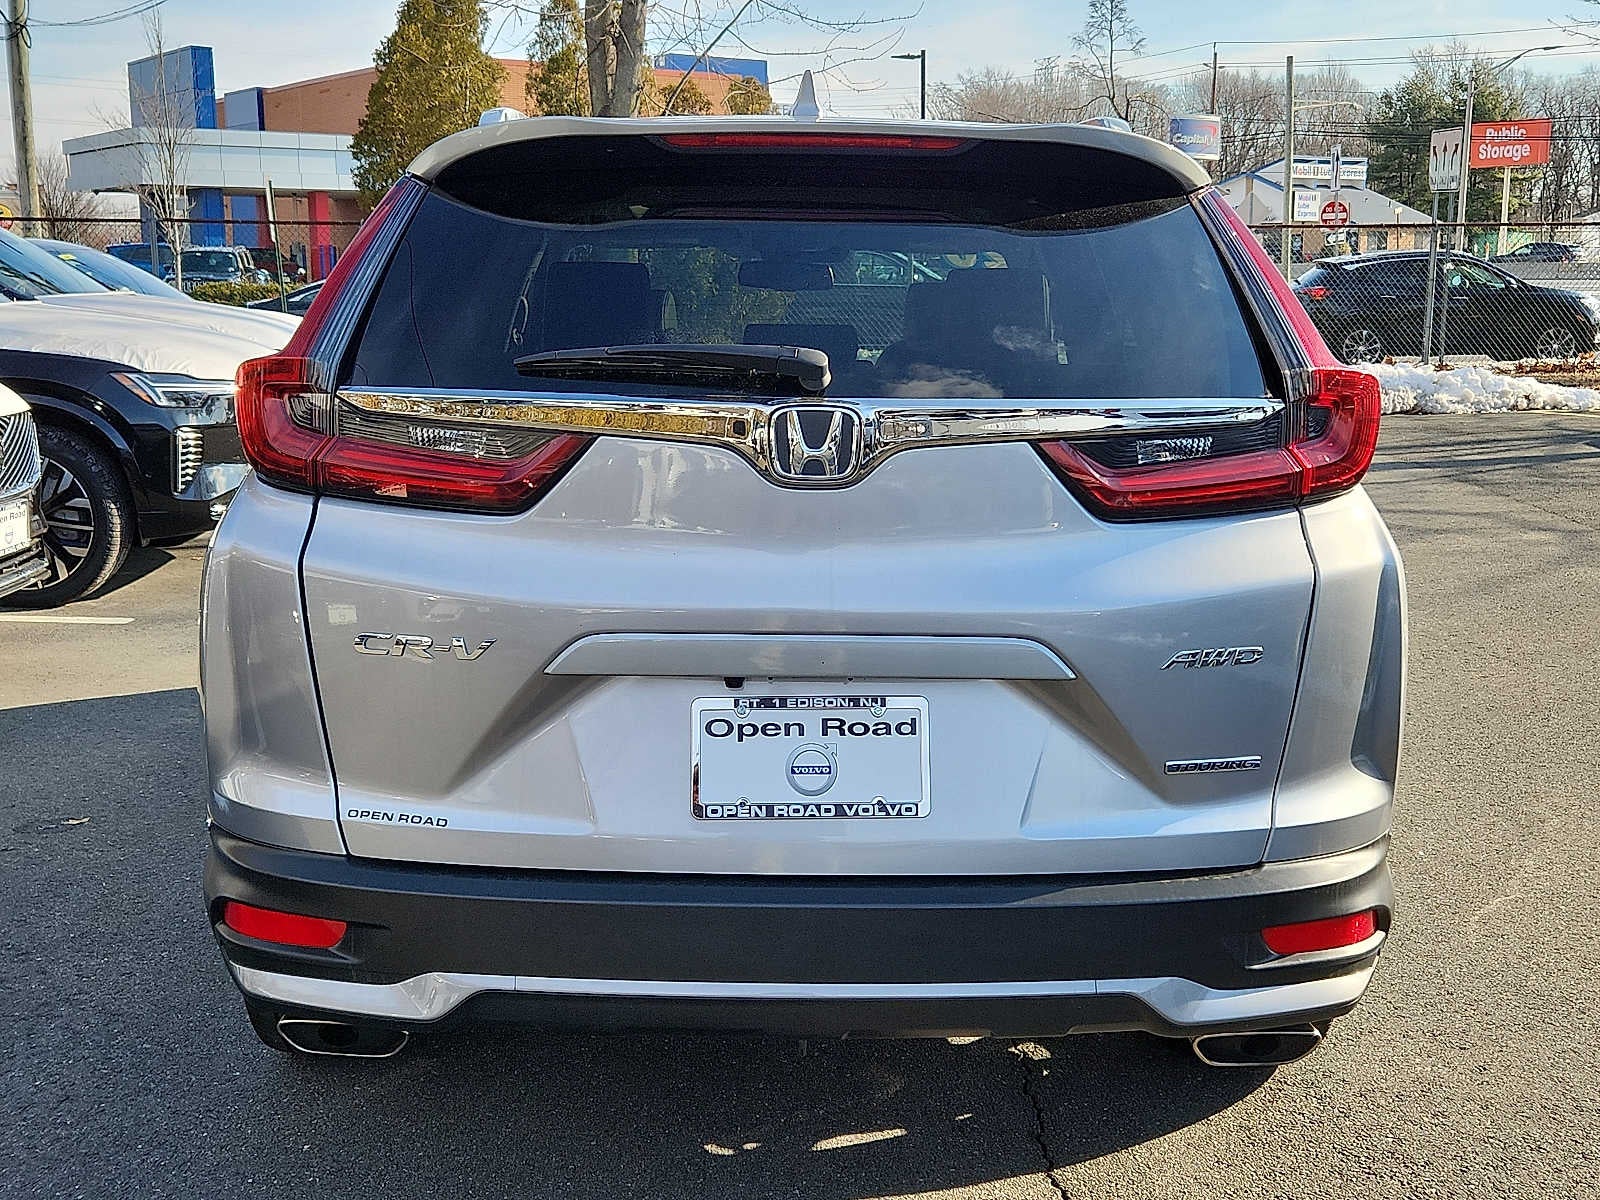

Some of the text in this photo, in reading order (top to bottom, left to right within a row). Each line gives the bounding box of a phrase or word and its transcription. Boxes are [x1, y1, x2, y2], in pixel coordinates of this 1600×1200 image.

[1485, 126, 1527, 142] Public
[1478, 144, 1531, 161] Storage
[1320, 166, 1333, 177] Lub
[353, 632, 498, 662] CR-V
[1161, 645, 1264, 670] AWD
[739, 698, 881, 709] RT. 1 EDISON, NJ
[704, 717, 917, 742] Open Road
[793, 766, 830, 775] VOLVO
[1167, 758, 1261, 773] TOURING
[347, 809, 448, 828] OPEN ROAD
[706, 804, 918, 818] OPEN ROAD VOLVO
